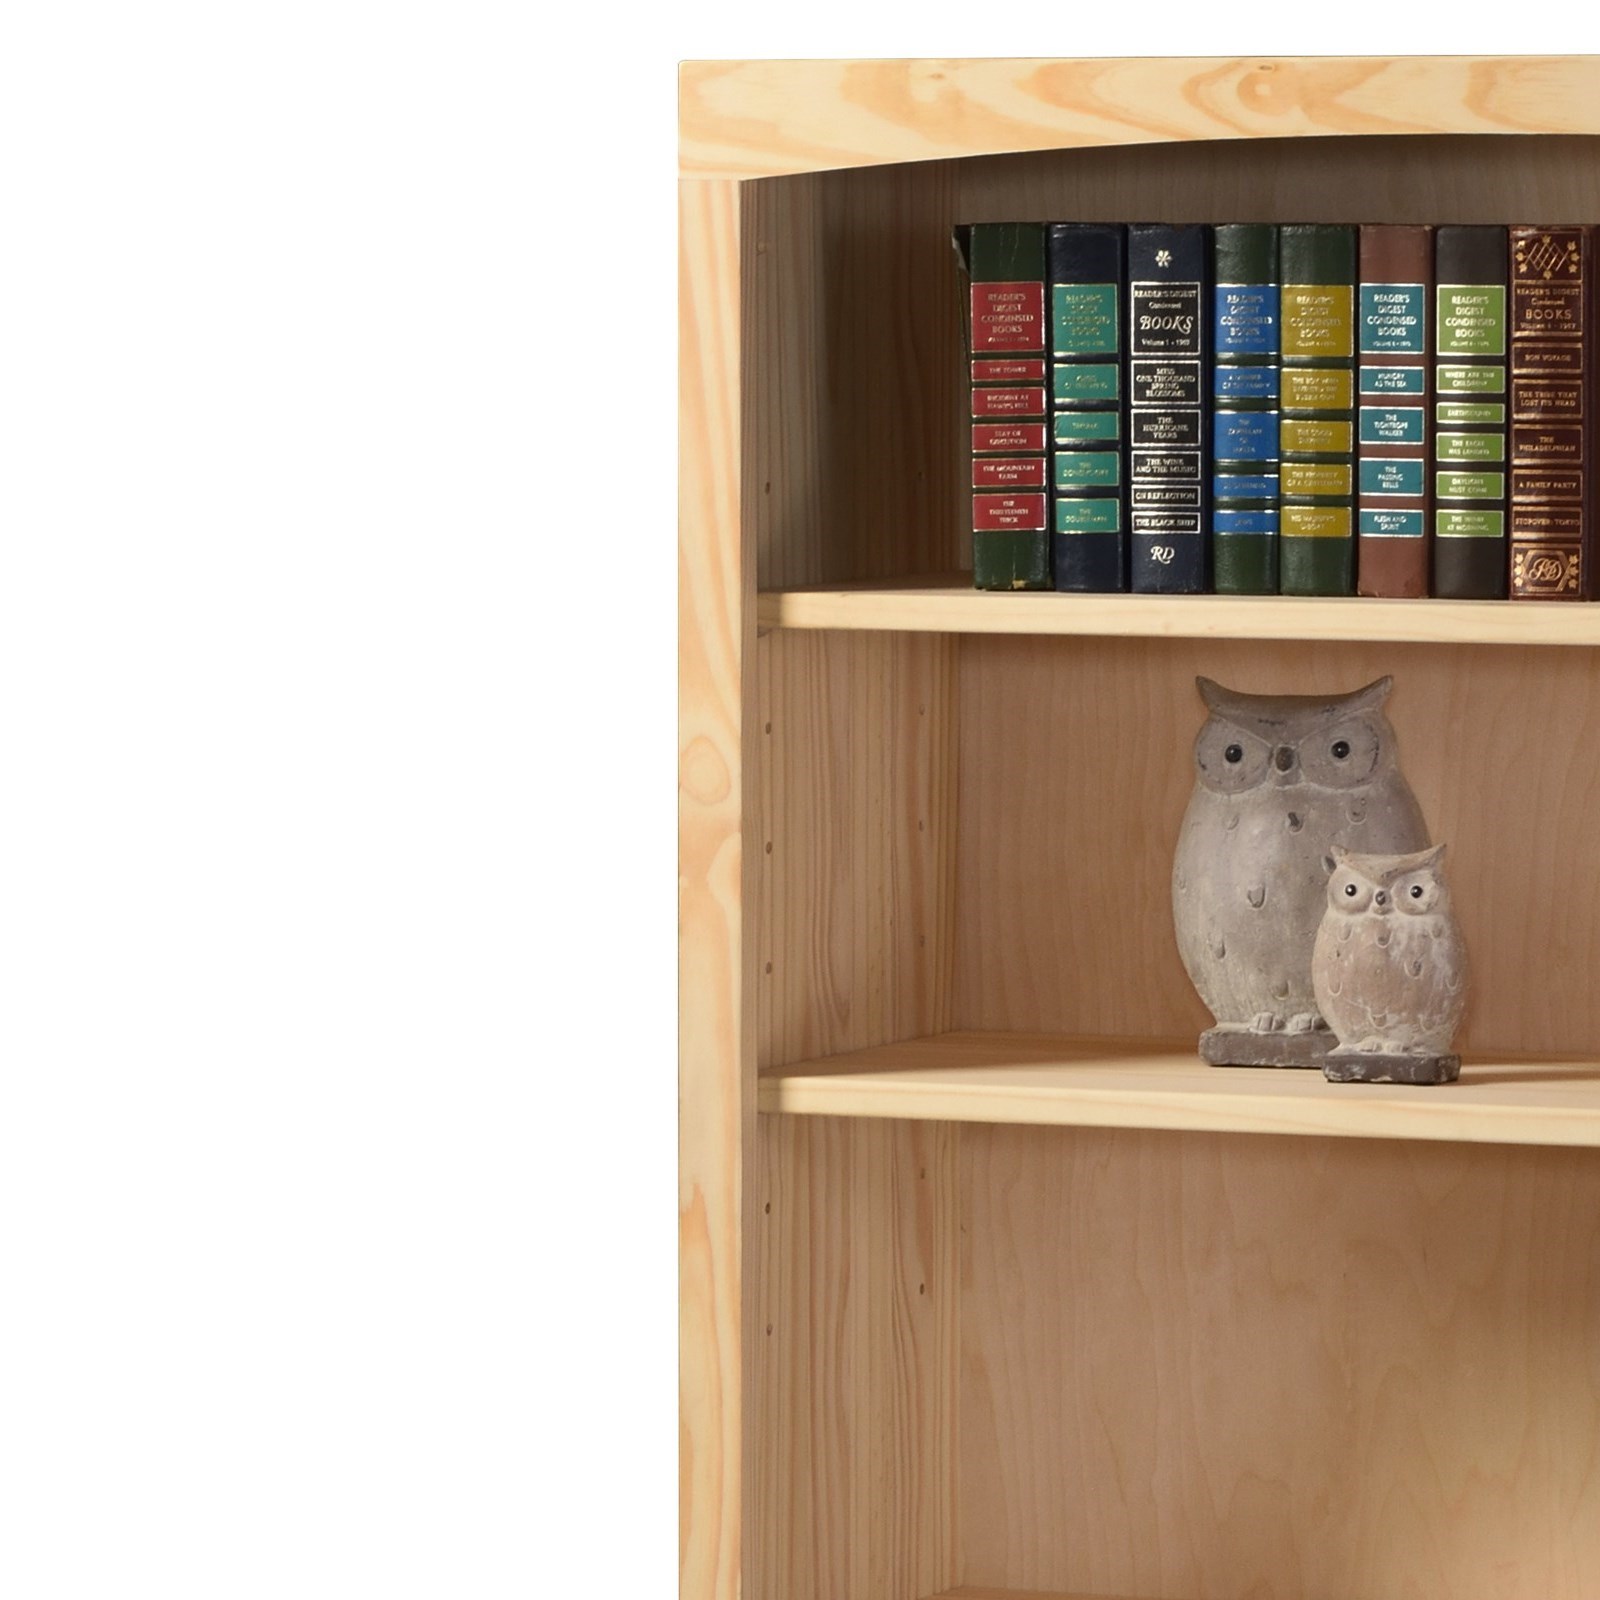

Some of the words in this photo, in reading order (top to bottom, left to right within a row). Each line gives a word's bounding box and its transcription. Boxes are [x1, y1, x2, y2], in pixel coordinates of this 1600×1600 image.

[1134, 290, 1168, 298] READER'S
[1170, 290, 1197, 298] DIGEST
[1517, 288, 1550, 296] READER'S
[1552, 288, 1580, 296] DIGEST
[1373, 294, 1410, 303] READER'S
[1451, 296, 1489, 305] READER'S
[993, 304, 1022, 312] DIGEST
[1377, 305, 1406, 314] DIGEST
[1455, 307, 1484, 315] DIGEST
[1525, 309, 1572, 320] BOOKS
[1140, 315, 1194, 334] BOOKS
[1366, 316, 1417, 325] CONDENSED
[1445, 318, 1496, 327] CONDENSED
[992, 326, 1023, 334] BOOKS
[1377, 327, 1407, 336] BOOKS
[1455, 329, 1485, 338] BOOKS
[1141, 338, 1165, 346] Volume
[1157, 417, 1174, 425] THE
[1142, 424, 1189, 432] HURRICANE
[1385, 466, 1397, 474] THE
[1135, 492, 1148, 500] ON
[1149, 492, 1196, 500] REFLECTION
[1135, 519, 1150, 527] THE
[1150, 519, 1176, 527] BLACK
[1176, 519, 1196, 527] SHIP
[1150, 545, 1175, 564] RD
